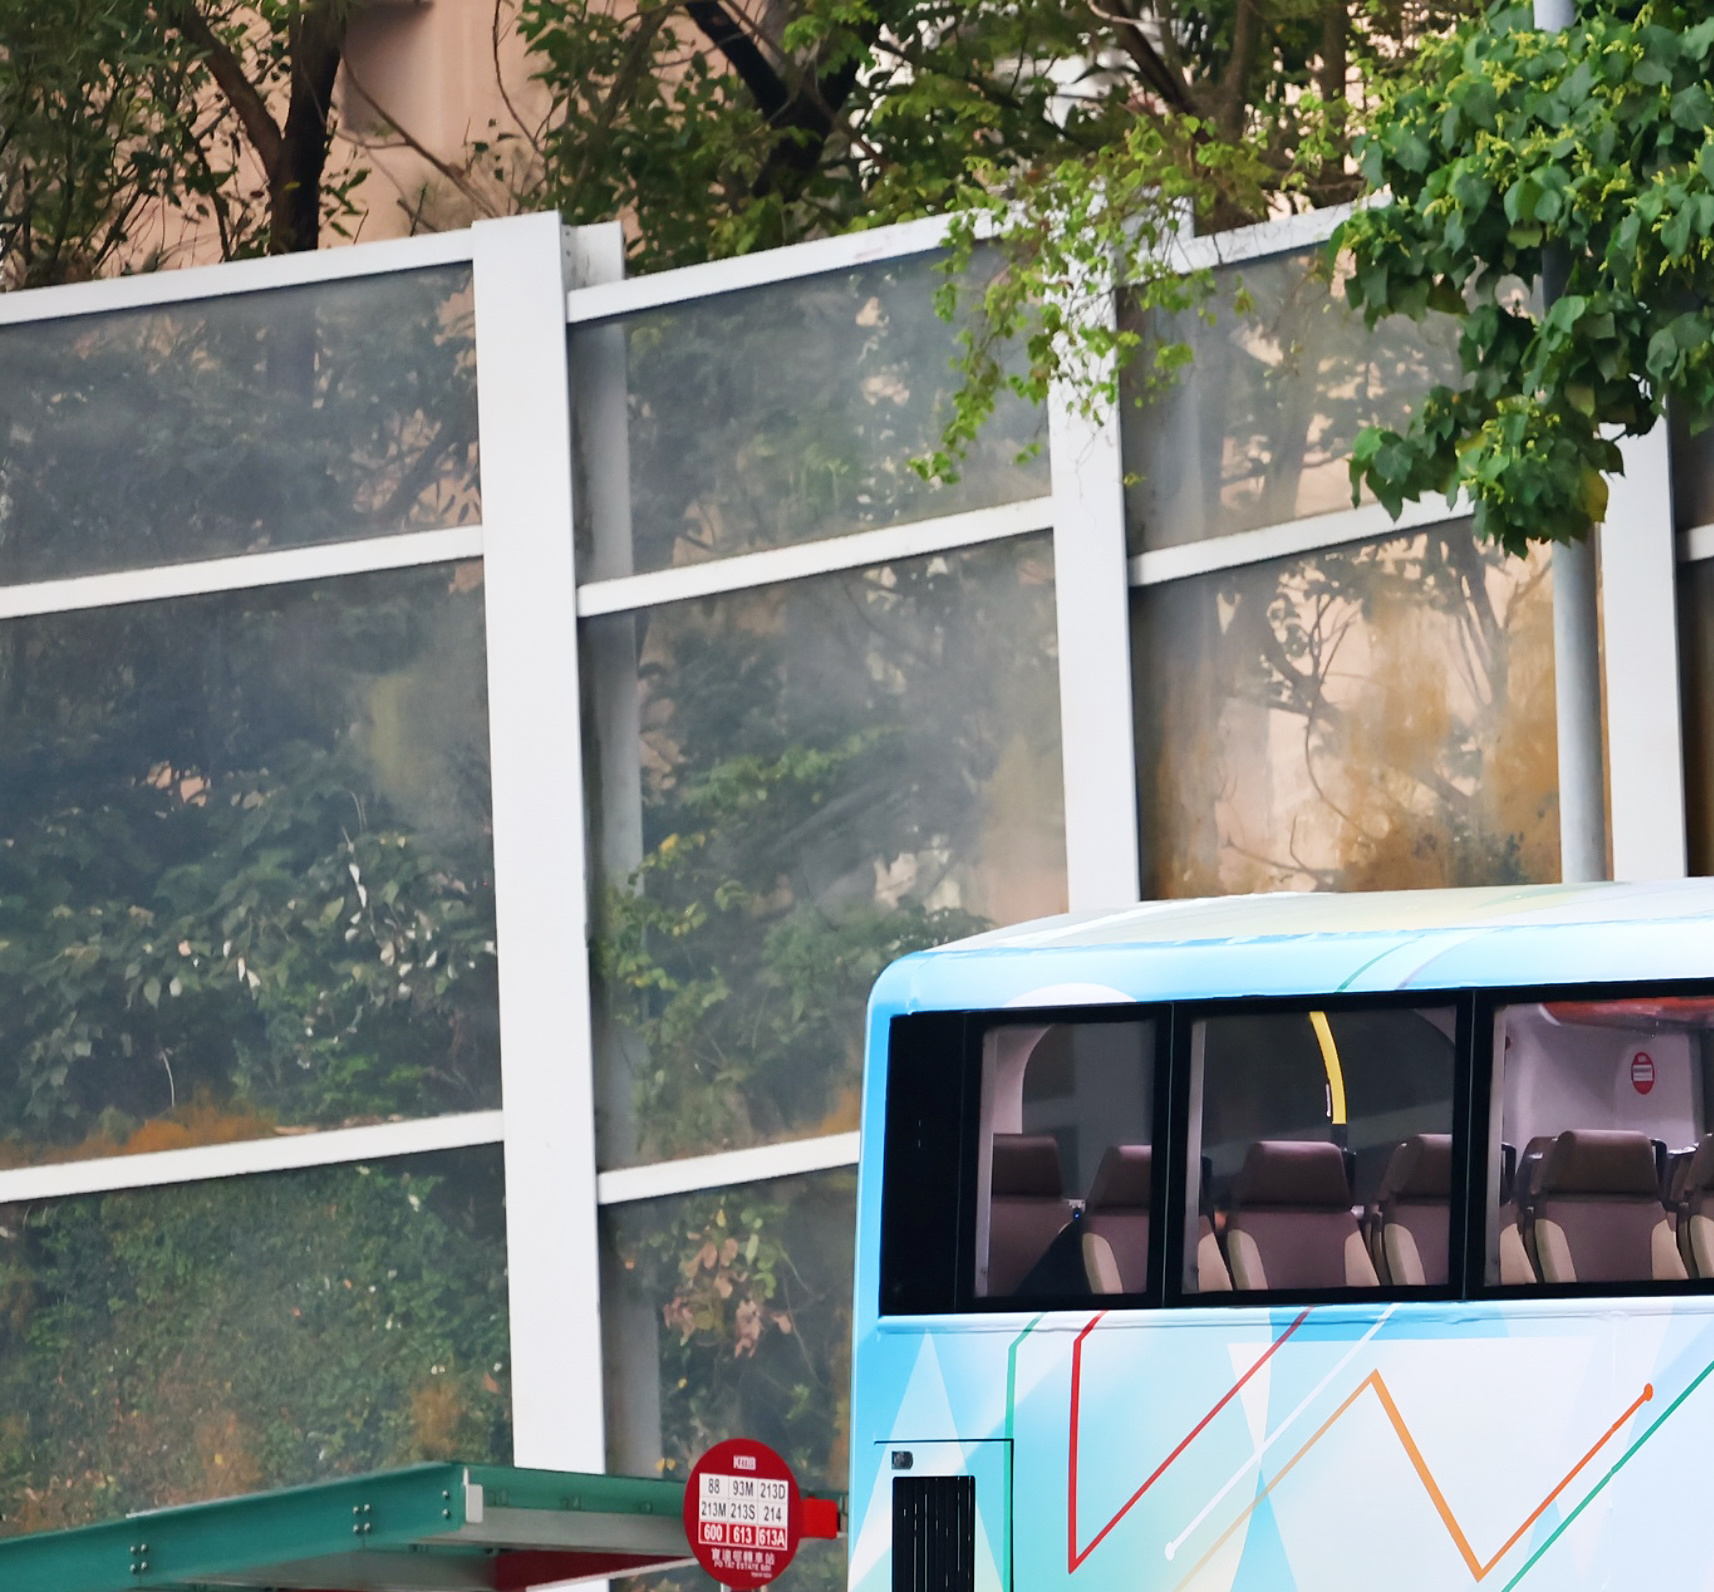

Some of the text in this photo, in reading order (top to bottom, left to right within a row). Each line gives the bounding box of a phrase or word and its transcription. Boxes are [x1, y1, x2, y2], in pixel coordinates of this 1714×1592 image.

[708, 1478, 786, 1500] 88 93M 213D
[701, 1501, 782, 1522] 213M 213S 214
[703, 1523, 785, 1547] 600 613 613A
